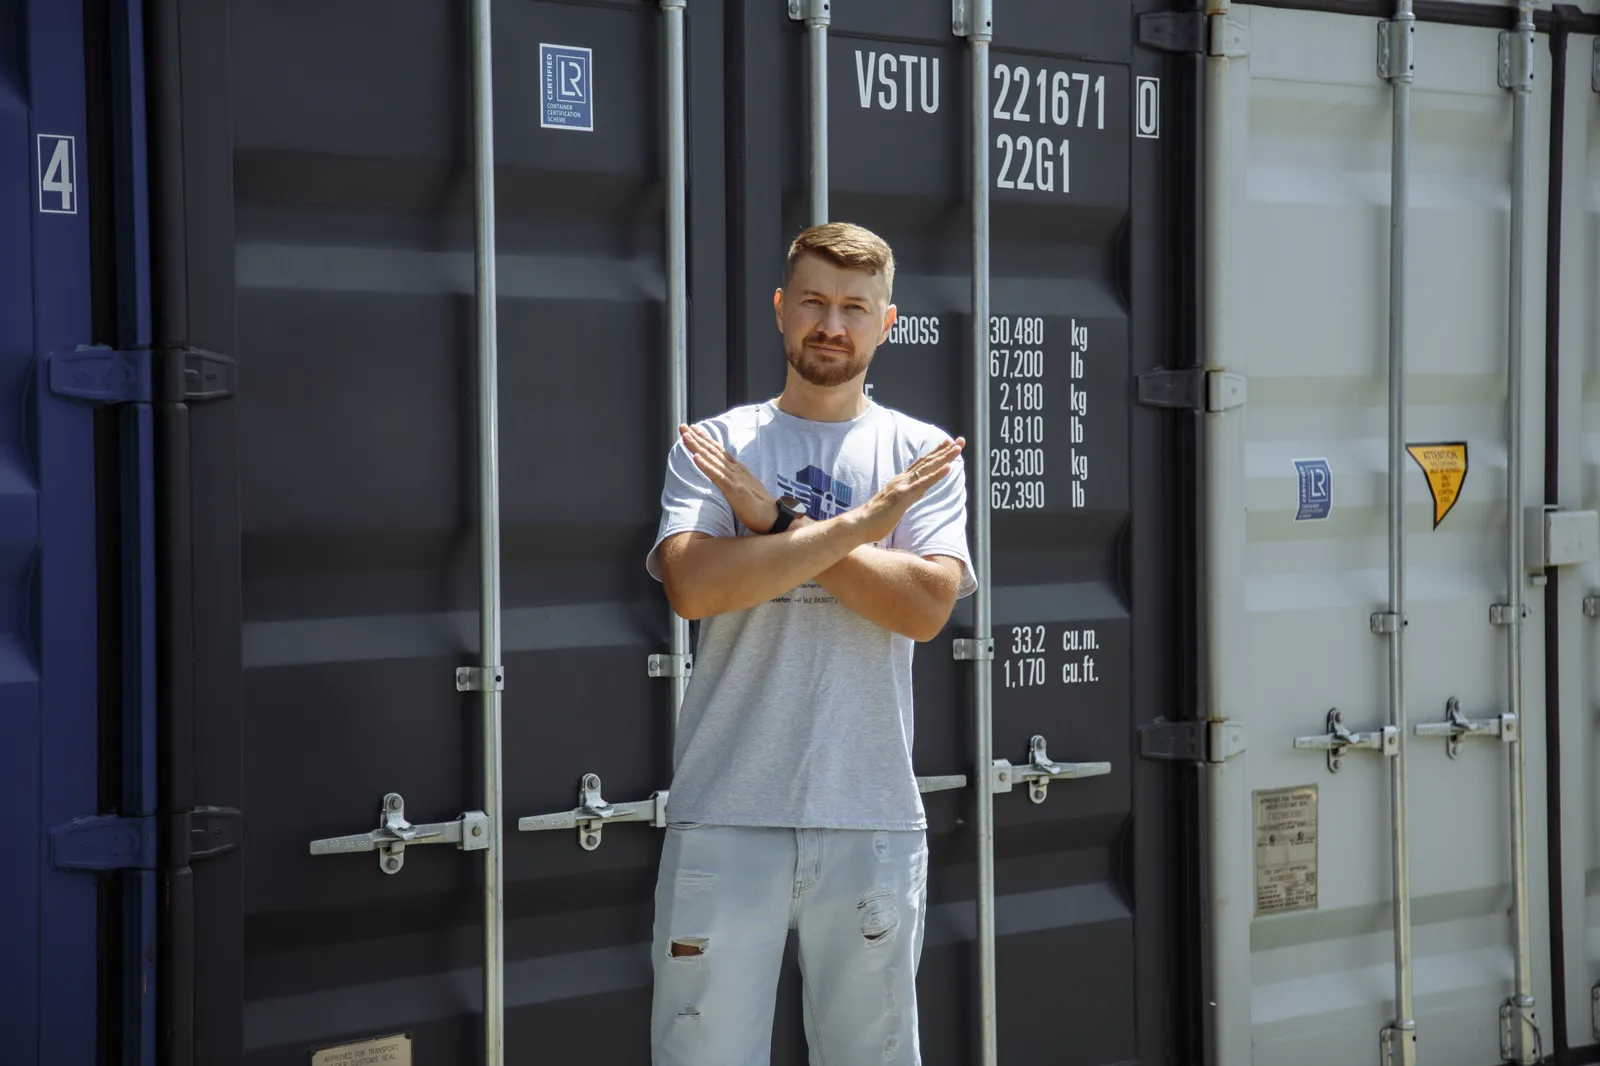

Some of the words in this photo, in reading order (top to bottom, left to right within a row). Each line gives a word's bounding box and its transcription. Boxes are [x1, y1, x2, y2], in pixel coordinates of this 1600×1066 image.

[561, 61, 583, 97] LR
[855, 50, 939, 114] VSTU
[993, 64, 1105, 130] 221671
[1139, 80, 1157, 134] 0
[546, 102, 573, 111] CONTAINER
[546, 109, 582, 118] CERTIFICATION
[42, 139, 73, 210] 4
[996, 133, 1070, 193] 22G1
[888, 315, 939, 345] GROSS
[989, 316, 1044, 346] 30,480
[1071, 318, 1088, 351] kg
[989, 349, 1043, 378] 67,200
[1070, 351, 1084, 379] lb
[999, 382, 1043, 412] 2,180
[1070, 383, 1087, 416] kg
[1000, 415, 1043, 445] 4,810
[1070, 415, 1083, 443] lb
[990, 448, 1044, 477] 28,300
[1071, 448, 1088, 481] kg
[990, 481, 1045, 510] 62,390
[1072, 480, 1085, 508] lb
[1310, 469, 1326, 497] LR
[769, 596, 791, 604] elefon:
[1012, 625, 1046, 654] 33.2
[1063, 629, 1099, 651] cu.m.
[1004, 657, 1046, 689] 1,170
[1062, 654, 1099, 683] cu.ft.
[323, 1052, 353, 1063] APPROVED
[355, 1050, 365, 1058] FOR
[368, 1044, 399, 1056] TRANSPORT
[381, 1053, 397, 1061] SEAL
